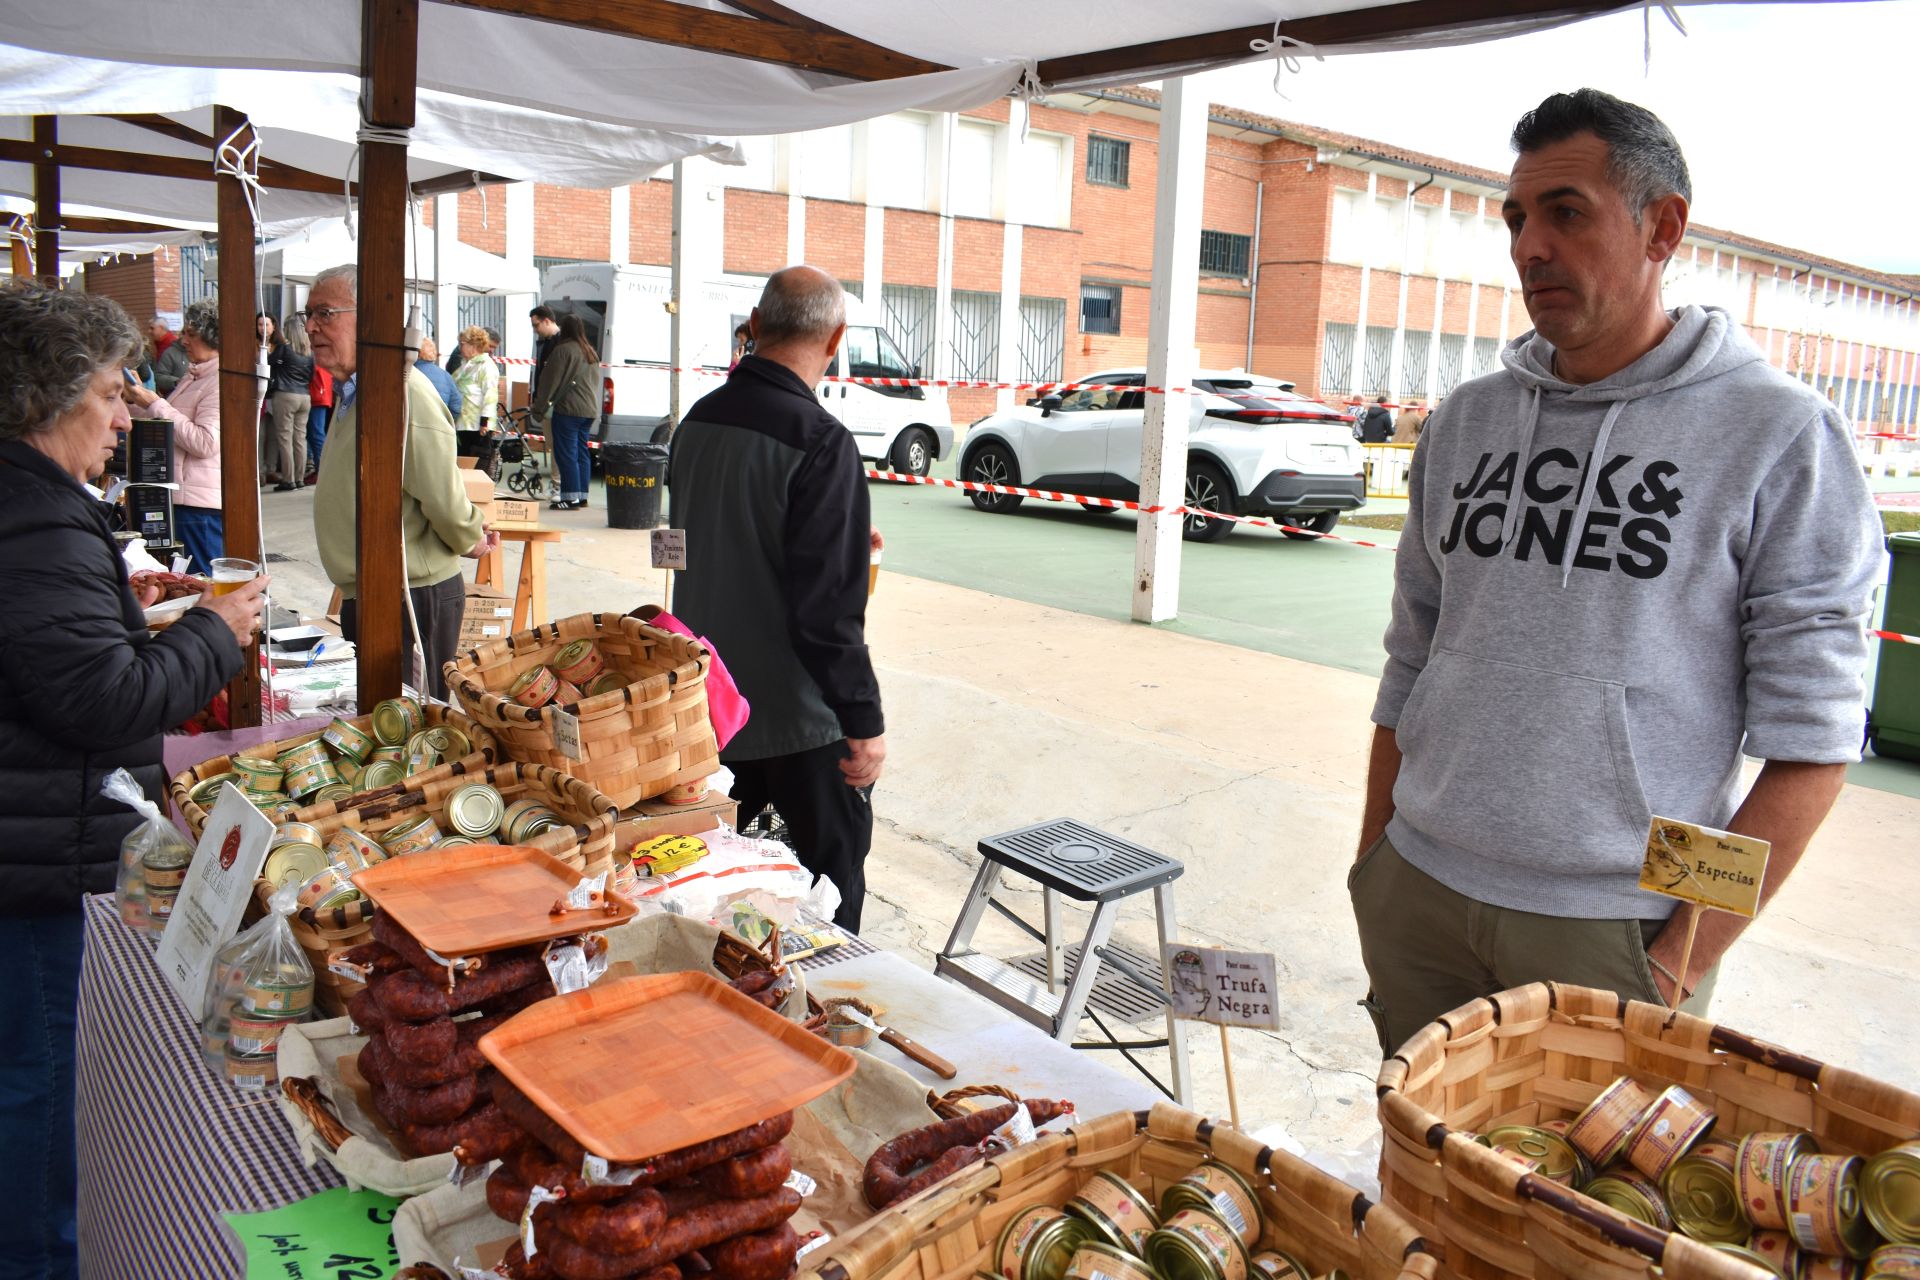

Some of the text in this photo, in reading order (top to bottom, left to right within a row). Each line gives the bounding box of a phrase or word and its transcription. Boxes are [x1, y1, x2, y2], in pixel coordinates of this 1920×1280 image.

[1440, 502, 1671, 580] JONES
[472, 607, 494, 616] FRASCO
[1696, 860, 1755, 886] Especias
[1216, 974, 1268, 994] Trufa
[1217, 995, 1271, 1018] Negra
